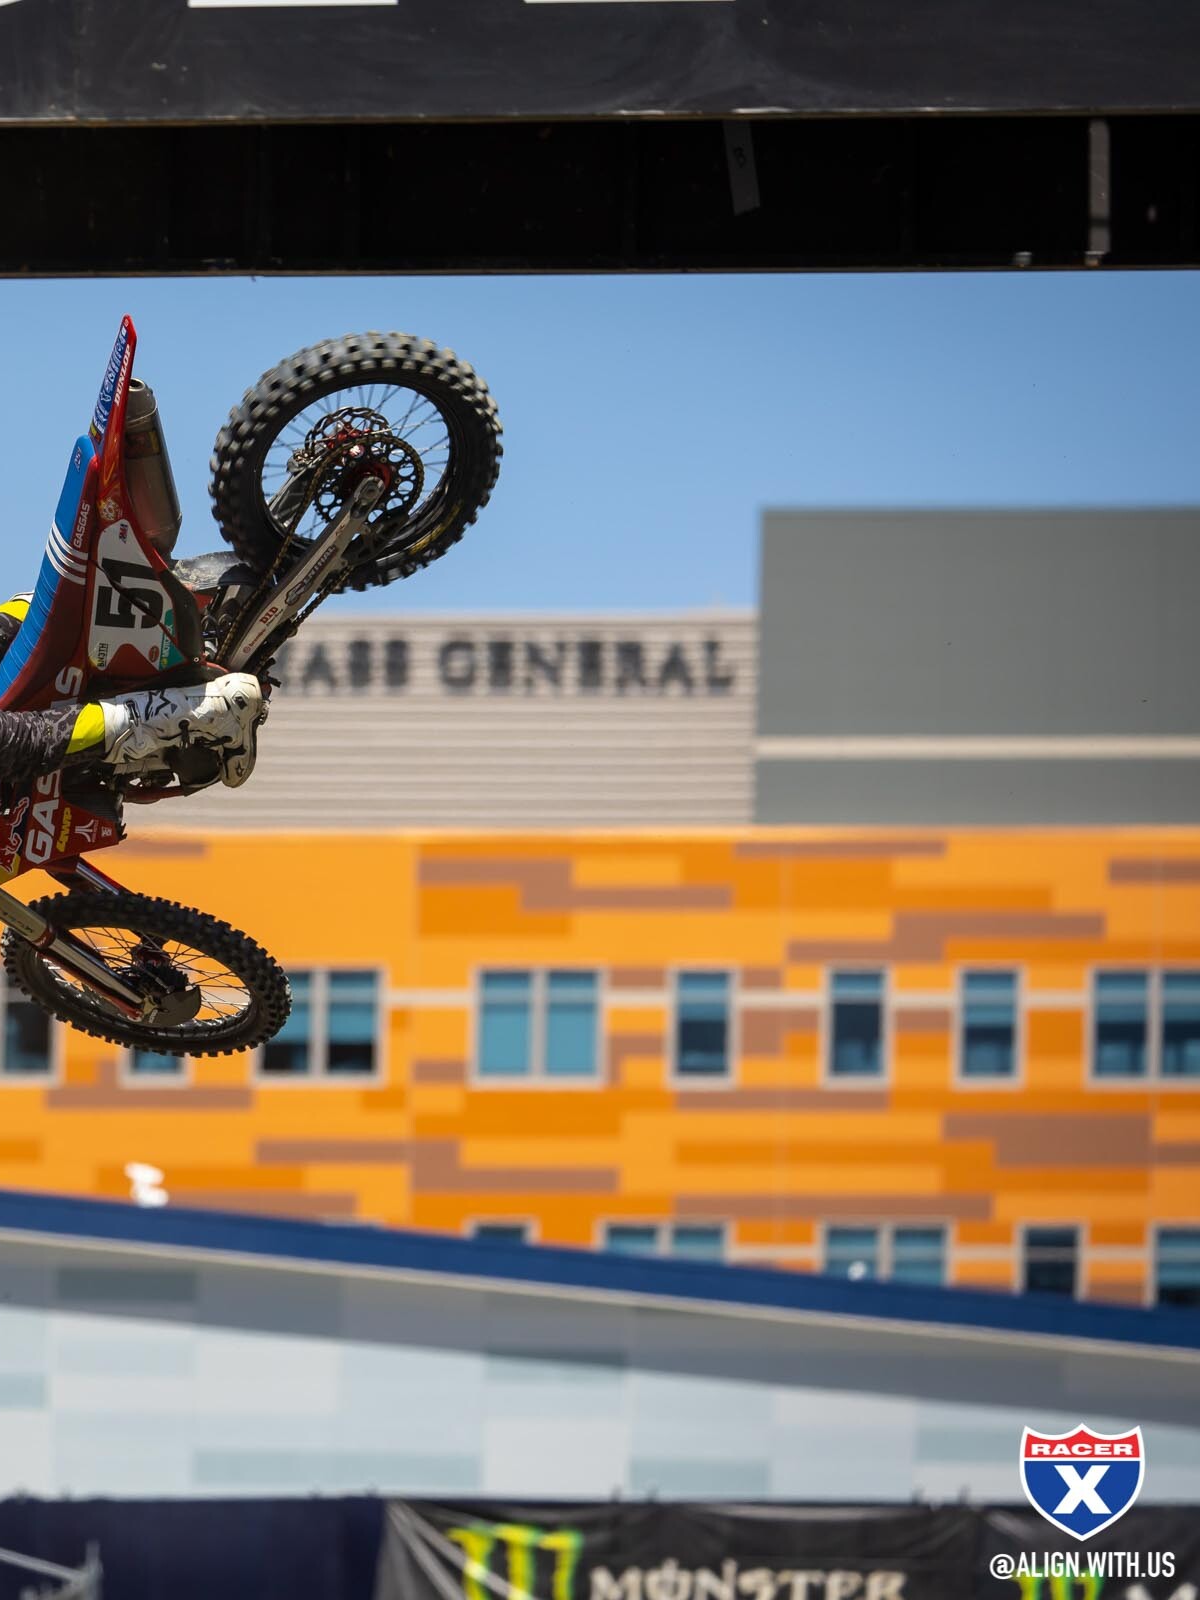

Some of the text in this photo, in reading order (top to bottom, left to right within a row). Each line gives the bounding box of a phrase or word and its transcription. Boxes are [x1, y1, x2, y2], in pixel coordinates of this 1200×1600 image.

[114, 343, 130, 407] DUNLOP
[73, 502, 91, 550] GASGAS
[94, 557, 164, 629] 51
[260, 606, 278, 624] DID
[436, 638, 738, 693] GENERAL
